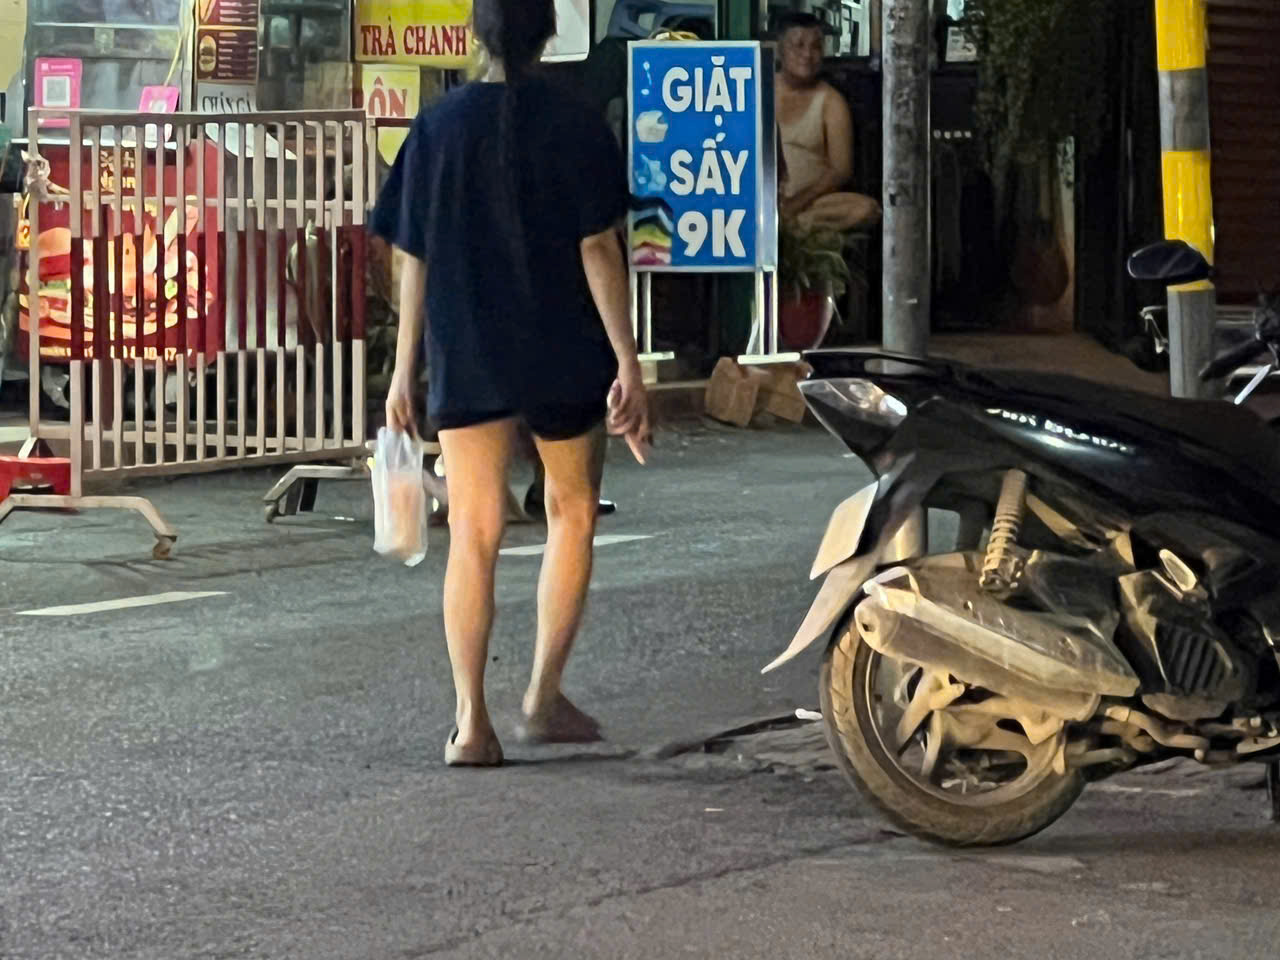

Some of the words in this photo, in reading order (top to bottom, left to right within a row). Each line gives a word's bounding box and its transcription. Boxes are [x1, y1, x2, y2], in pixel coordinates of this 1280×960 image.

[361, 16, 397, 56] TRÀ
[403, 24, 468, 56] CHANH
[661, 55, 753, 127] GIẶT
[669, 132, 750, 196] SẤY
[676, 208, 747, 258] 9K
